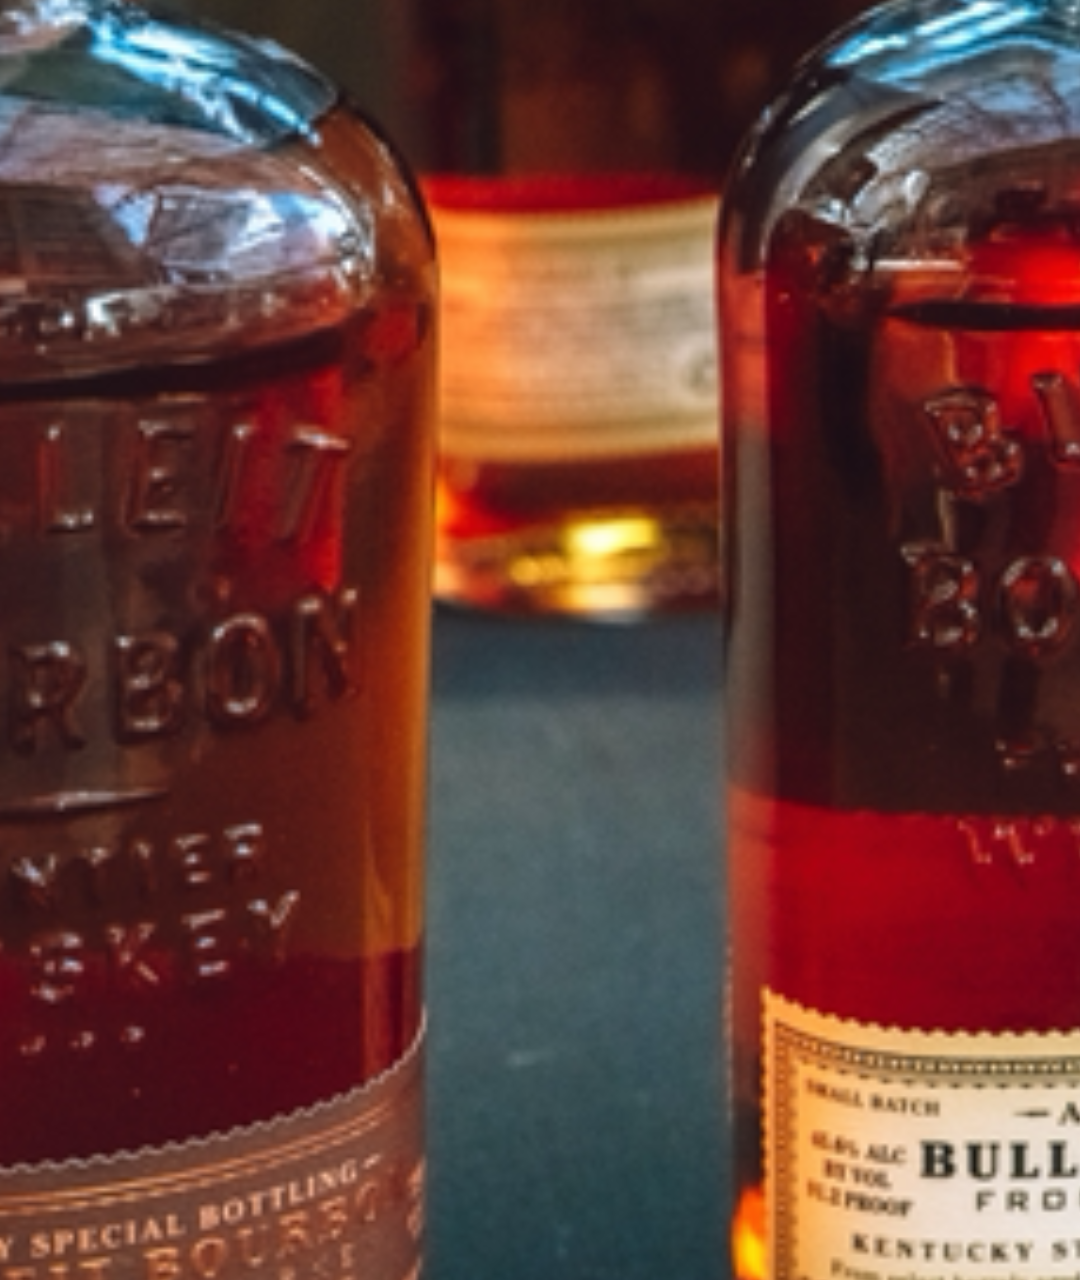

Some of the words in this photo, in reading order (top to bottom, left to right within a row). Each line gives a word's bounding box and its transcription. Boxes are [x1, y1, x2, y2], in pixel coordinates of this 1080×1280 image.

[870, 1092, 941, 1117] BATCH
[865, 1143, 907, 1165] ALC
[30, 1214, 187, 1258] SPECIAL
[199, 1158, 357, 1231] BOTTLING
[845, 1190, 915, 1218] PROOF
[850, 1232, 1034, 1262] KENTUCKY
